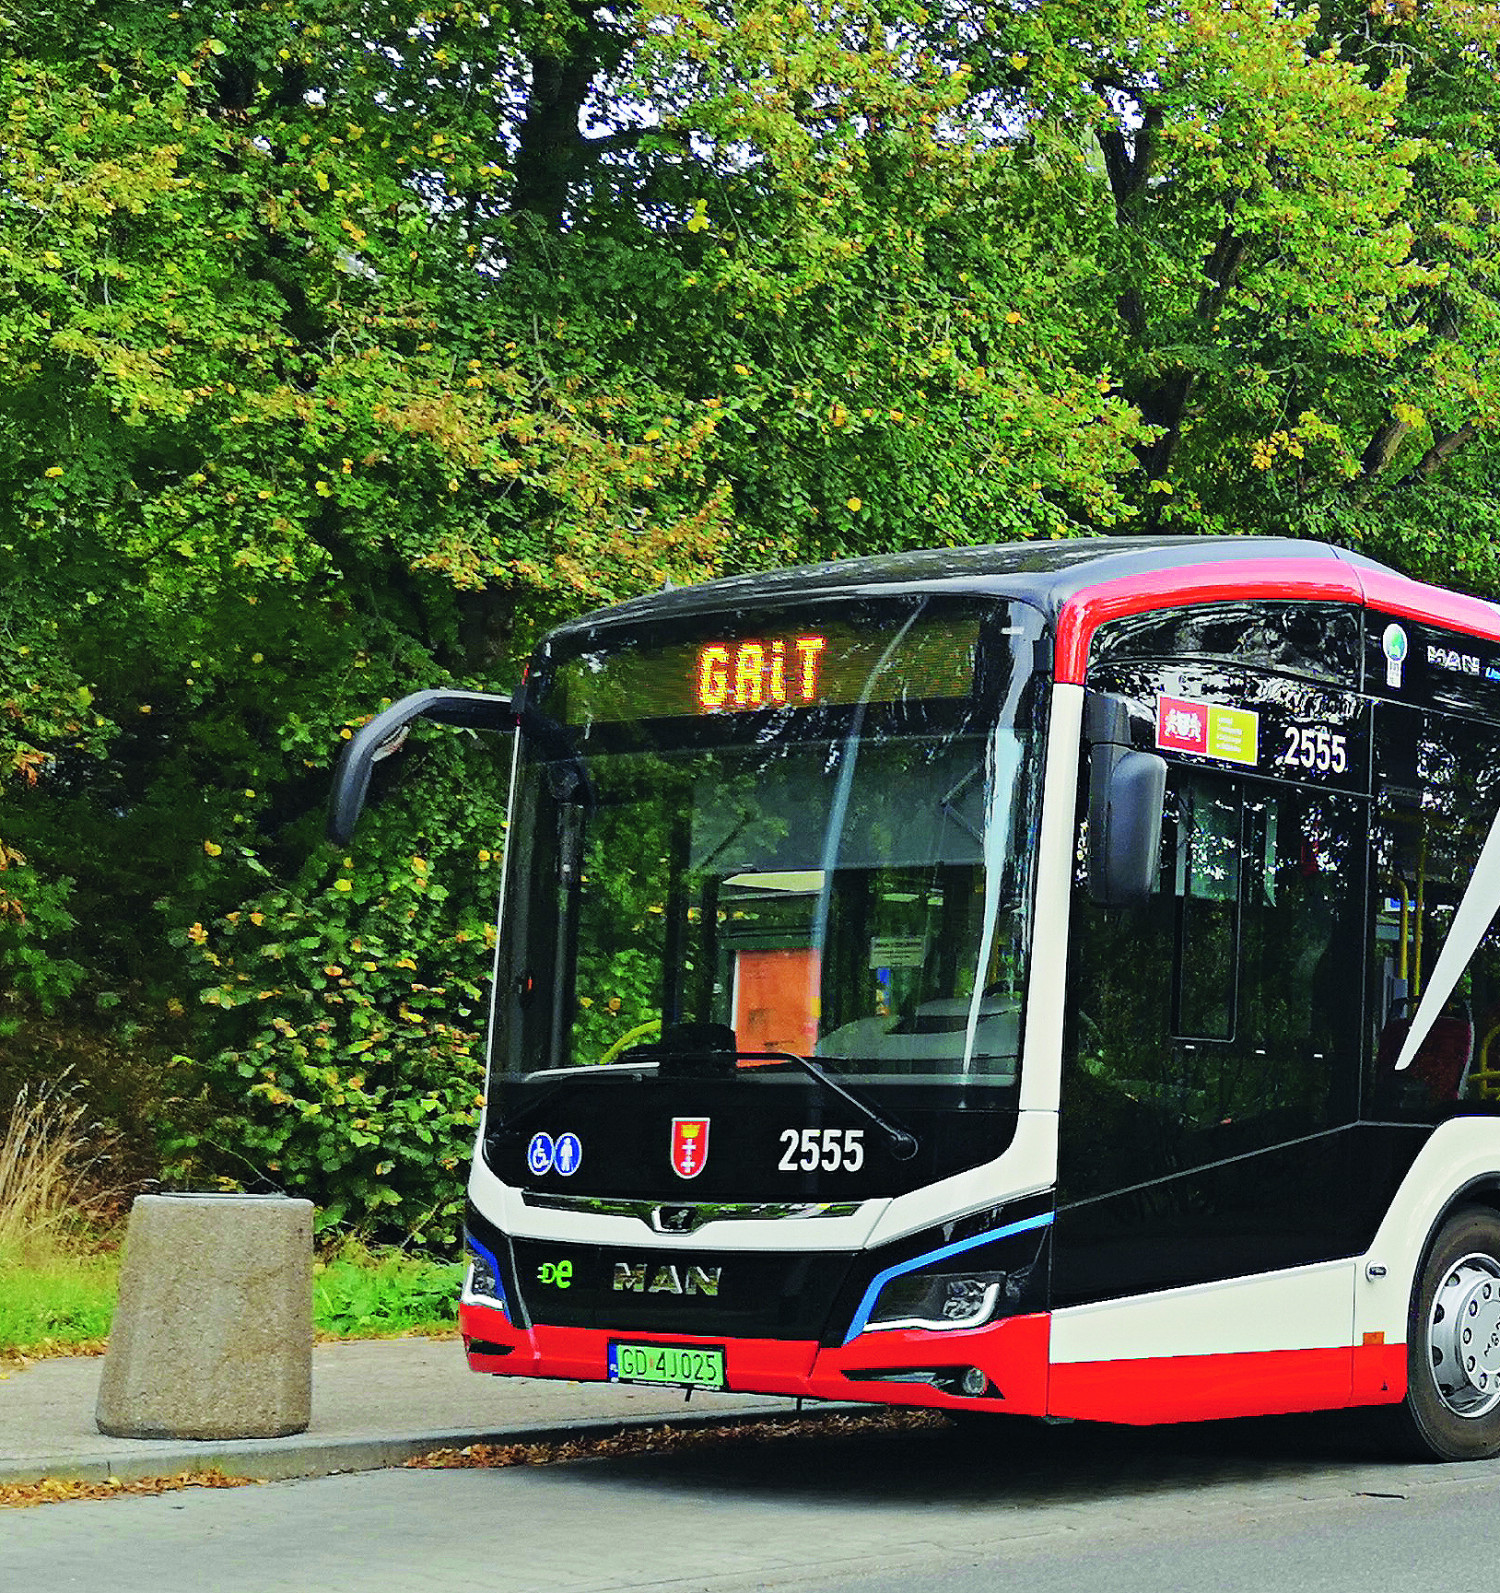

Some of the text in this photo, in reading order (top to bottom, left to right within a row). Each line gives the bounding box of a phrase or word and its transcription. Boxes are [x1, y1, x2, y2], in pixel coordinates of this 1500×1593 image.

[1427, 645, 1480, 676] MAN
[1284, 726, 1346, 774] 2555
[778, 1129, 865, 1172] 2555
[613, 1262, 722, 1296] MAN
[622, 1348, 717, 1381] GD 4J025
